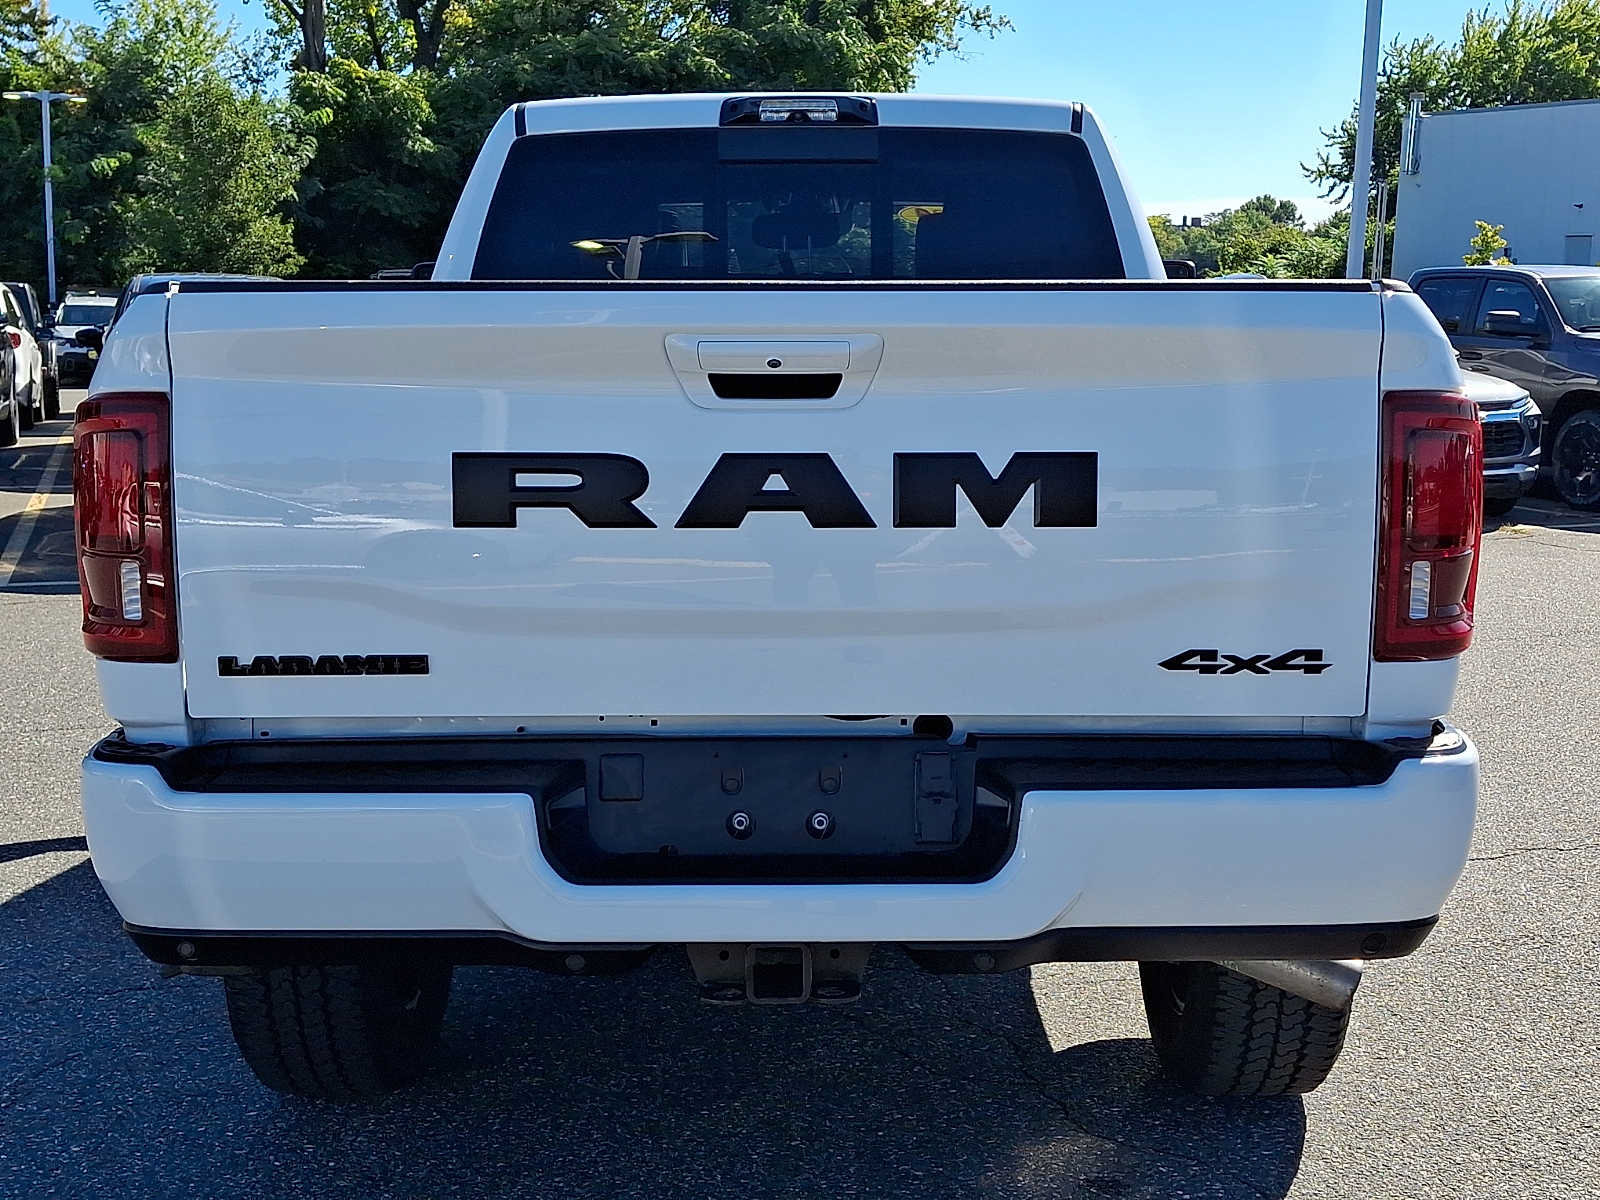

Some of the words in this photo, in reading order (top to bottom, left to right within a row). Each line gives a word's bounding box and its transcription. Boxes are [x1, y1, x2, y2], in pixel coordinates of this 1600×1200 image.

[452, 452, 1098, 529] RAM
[217, 655, 430, 677] LARAMIE
[1158, 649, 1334, 674] 4x4
